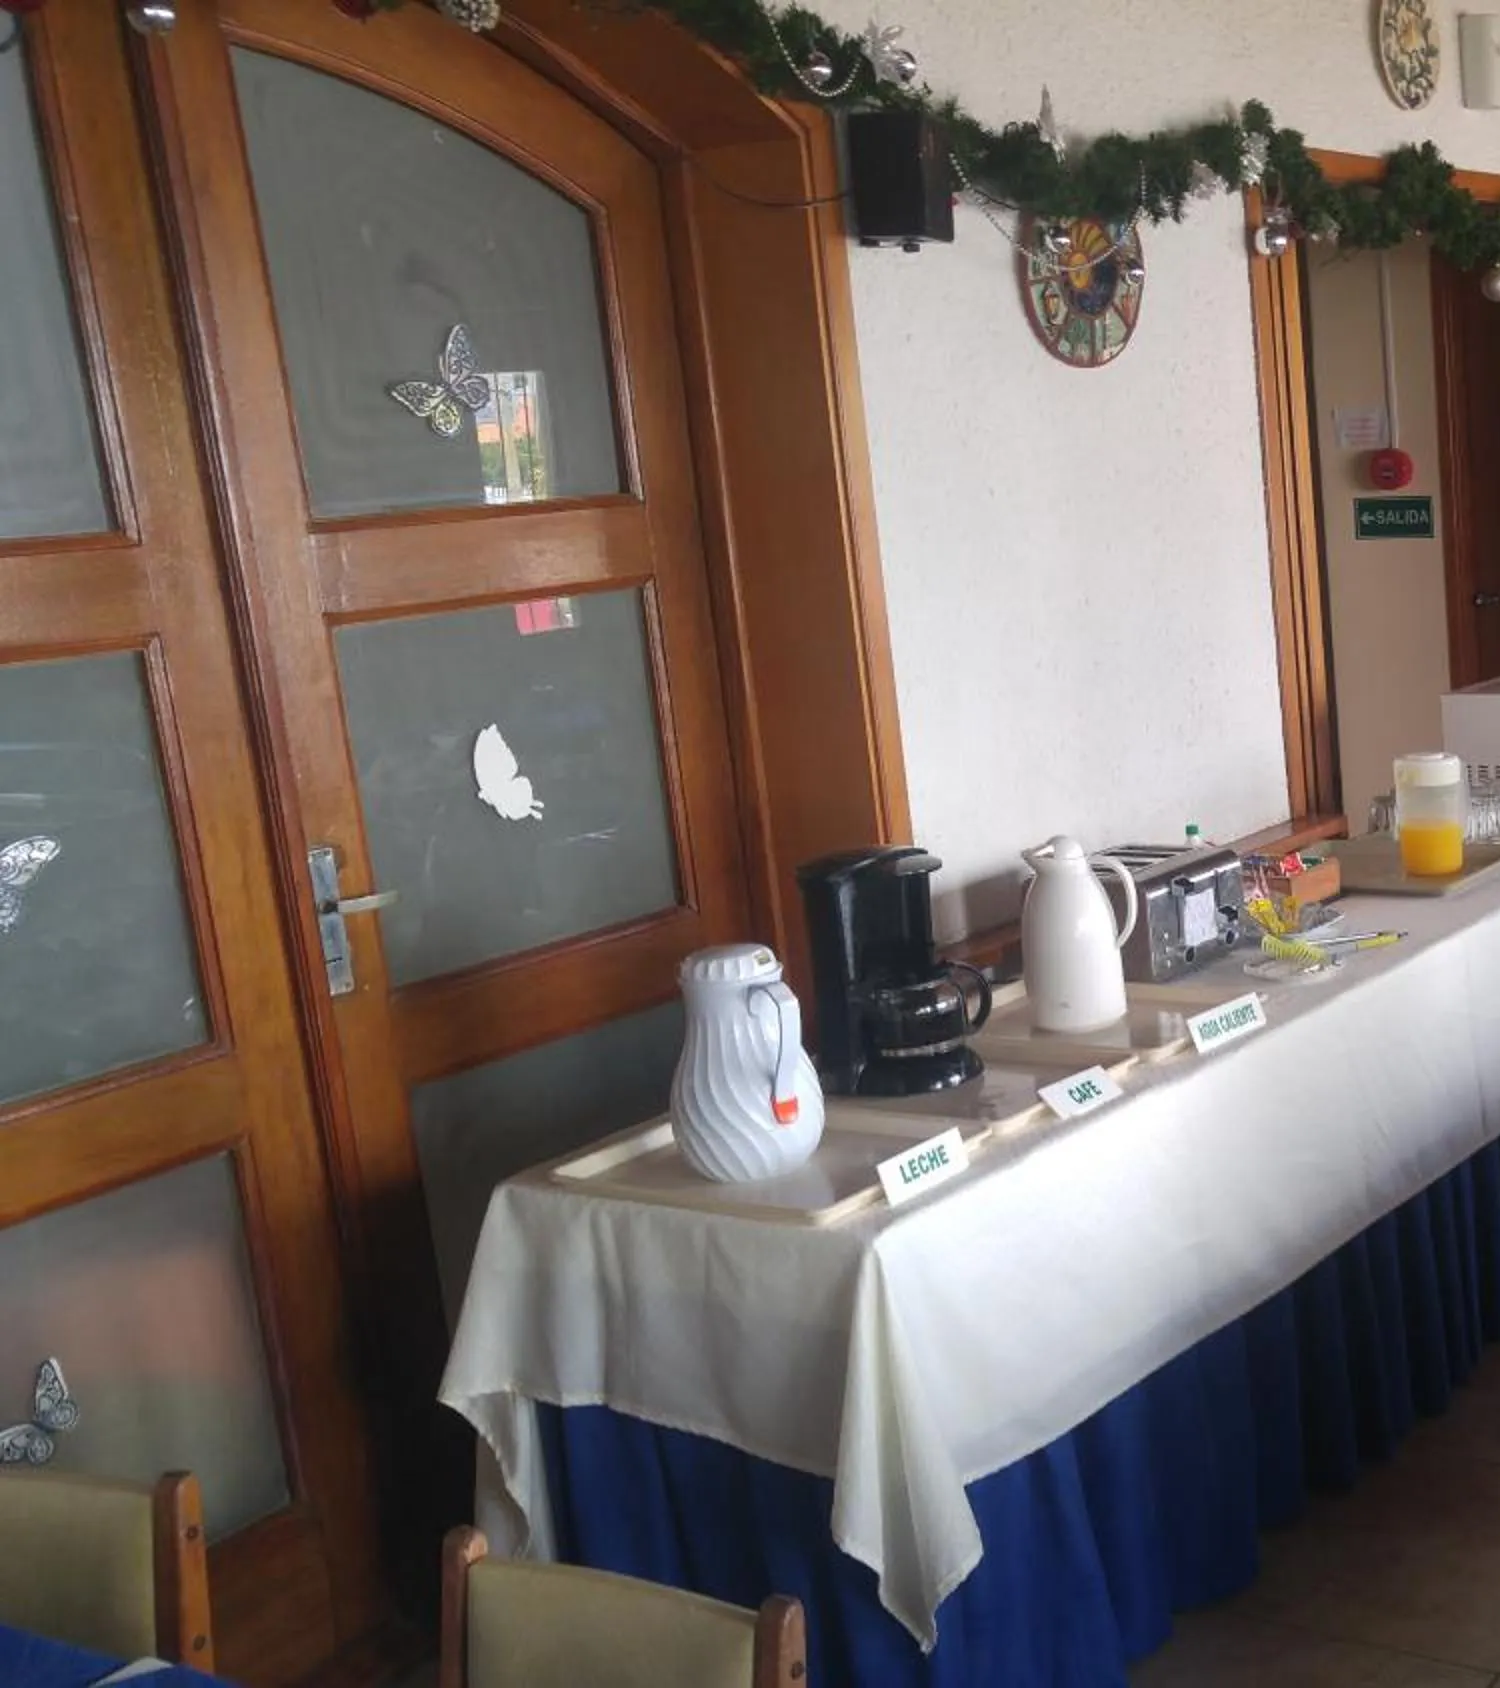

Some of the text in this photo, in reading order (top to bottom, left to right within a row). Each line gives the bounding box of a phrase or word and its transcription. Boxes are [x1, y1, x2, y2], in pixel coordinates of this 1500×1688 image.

[1375, 509, 1429, 525] SALIDA
[1068, 1080, 1103, 1104] CAFE
[899, 1144, 949, 1185] LECHE
